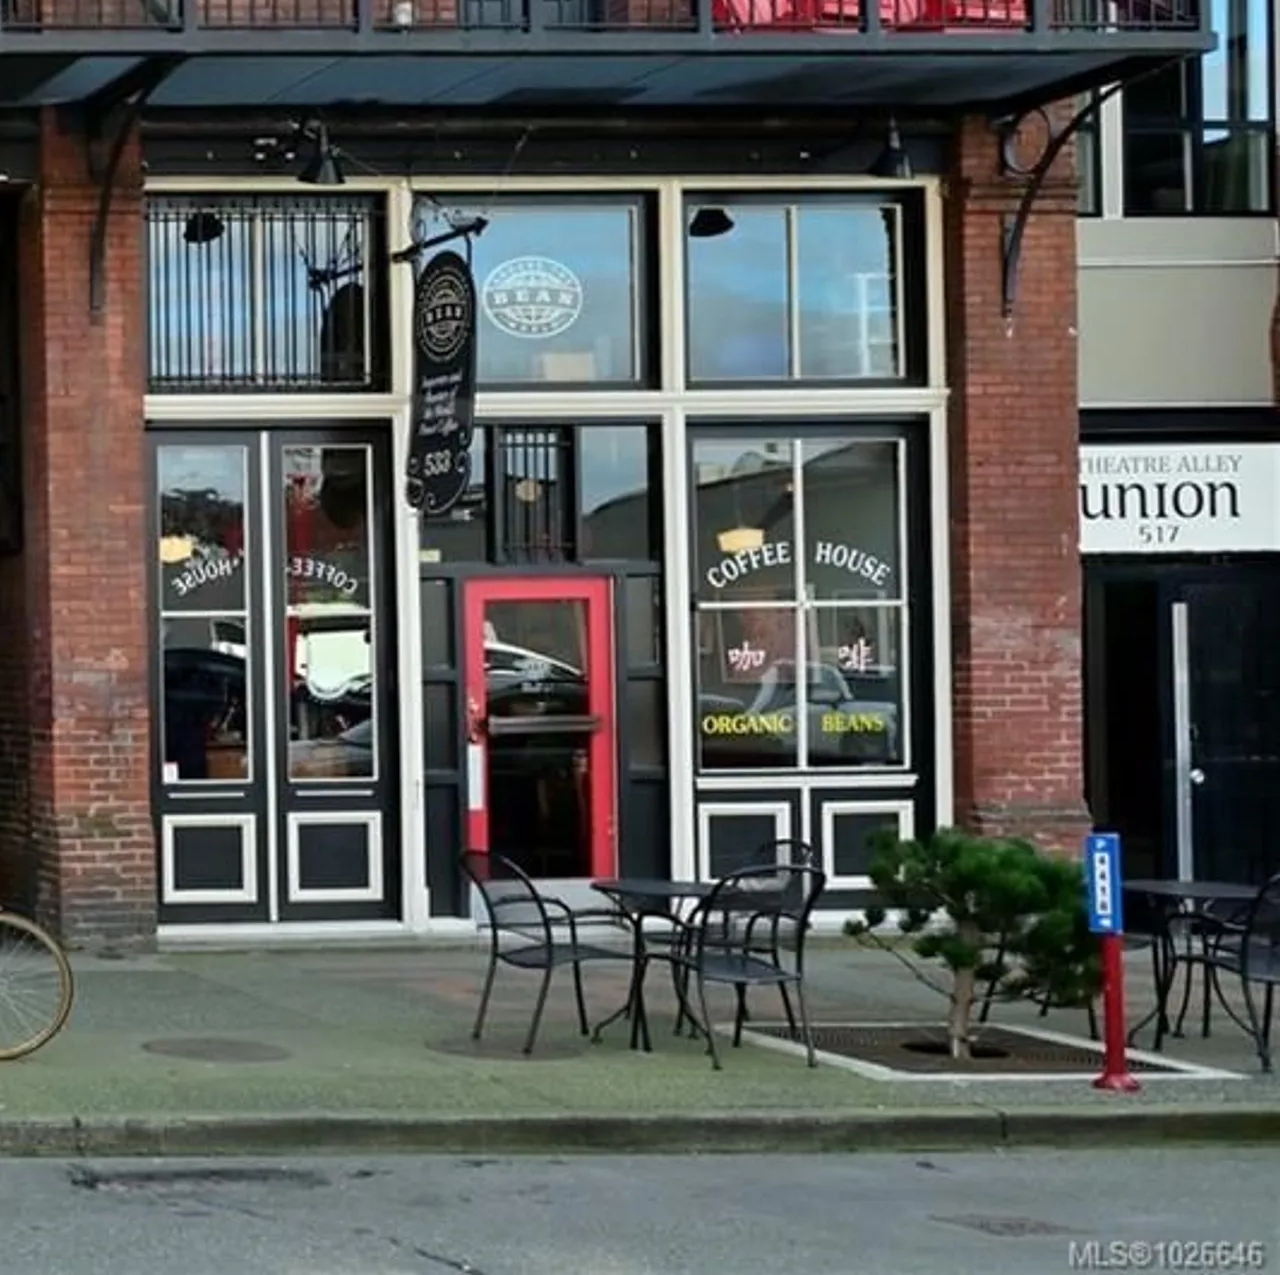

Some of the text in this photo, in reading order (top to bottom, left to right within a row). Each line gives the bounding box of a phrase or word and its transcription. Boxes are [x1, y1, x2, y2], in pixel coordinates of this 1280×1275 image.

[1176, 454, 1242, 473] ALLEY
[1138, 525, 1180, 544] 517
[706, 540, 891, 588] COFFEE HOUSE
[702, 712, 885, 734] ORGANIC BEANS
